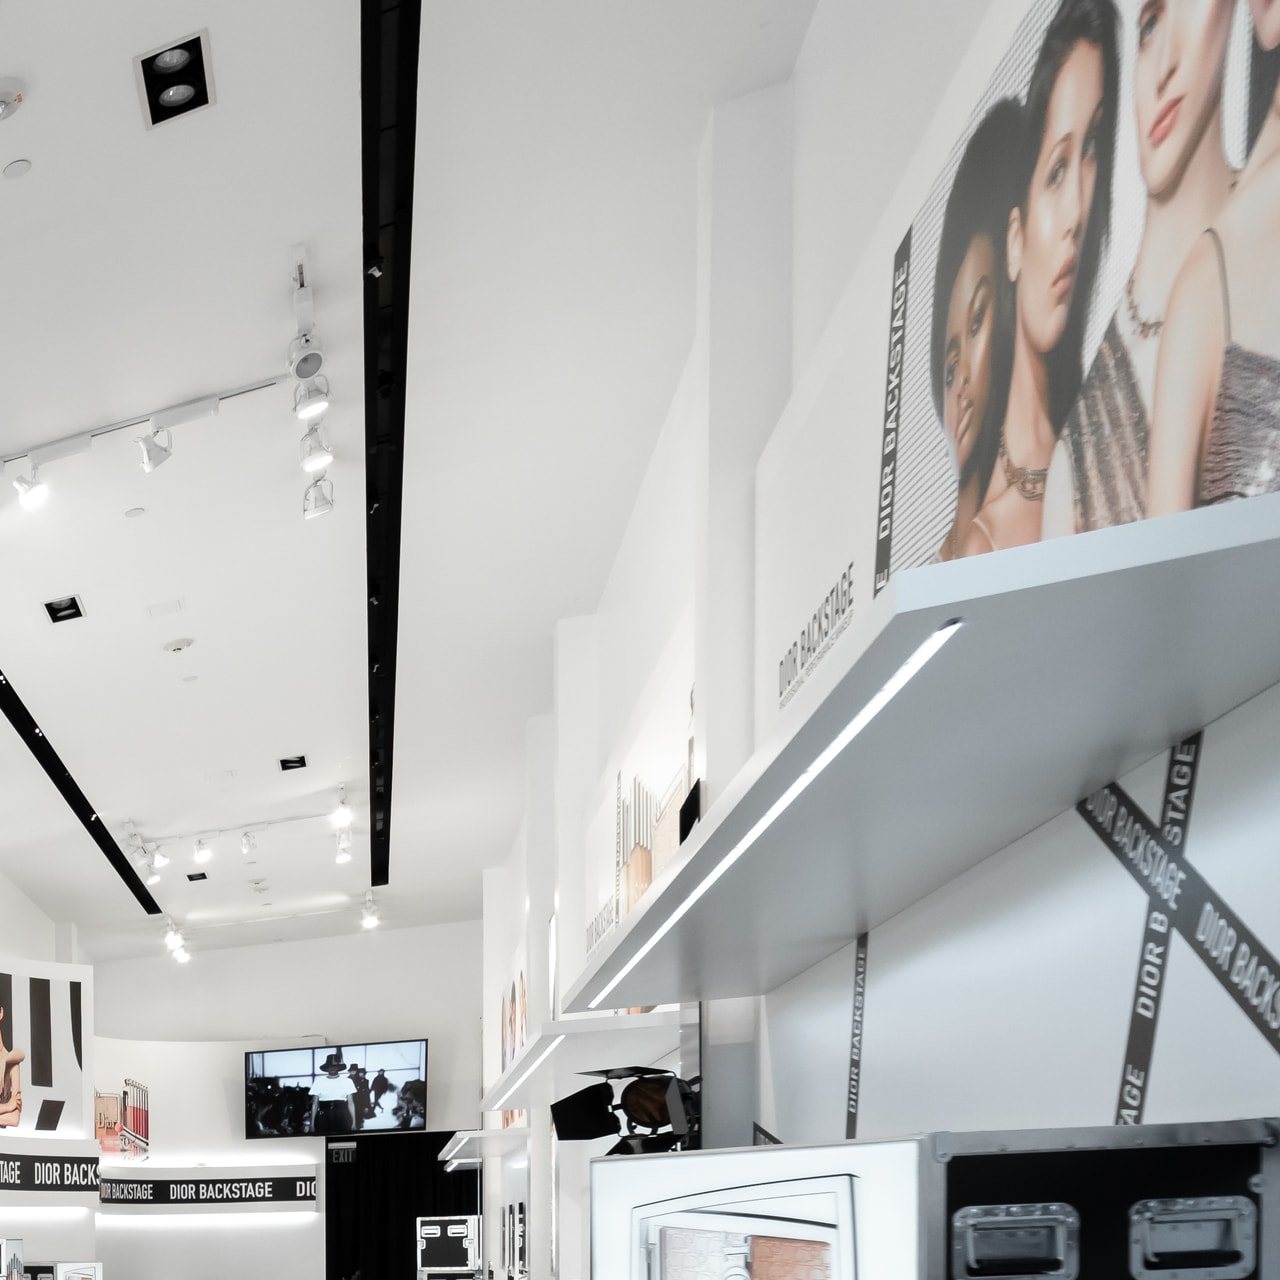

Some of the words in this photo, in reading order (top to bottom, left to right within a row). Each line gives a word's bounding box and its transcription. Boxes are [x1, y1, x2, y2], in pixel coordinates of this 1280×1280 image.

[884, 259, 908, 457] BACKSTAGE
[878, 460, 894, 540] DIOR
[800, 561, 854, 670] BACKSTAGE
[1113, 805, 1187, 911] BACKSTAGE
[1195, 901, 1237, 972] DIOR
[851, 950, 865, 1061] BACKSTAGE
[1136, 942, 1165, 1019] DIOR
[848, 1066, 859, 1113] DIOR
[34, 1163, 60, 1185] DIOR
[112, 1183, 153, 1200] BACKSTAGE
[170, 1183, 196, 1200] DIOR
[199, 1182, 273, 1199] BACKSTAGE
[332, 1149, 354, 1163] EXIT
